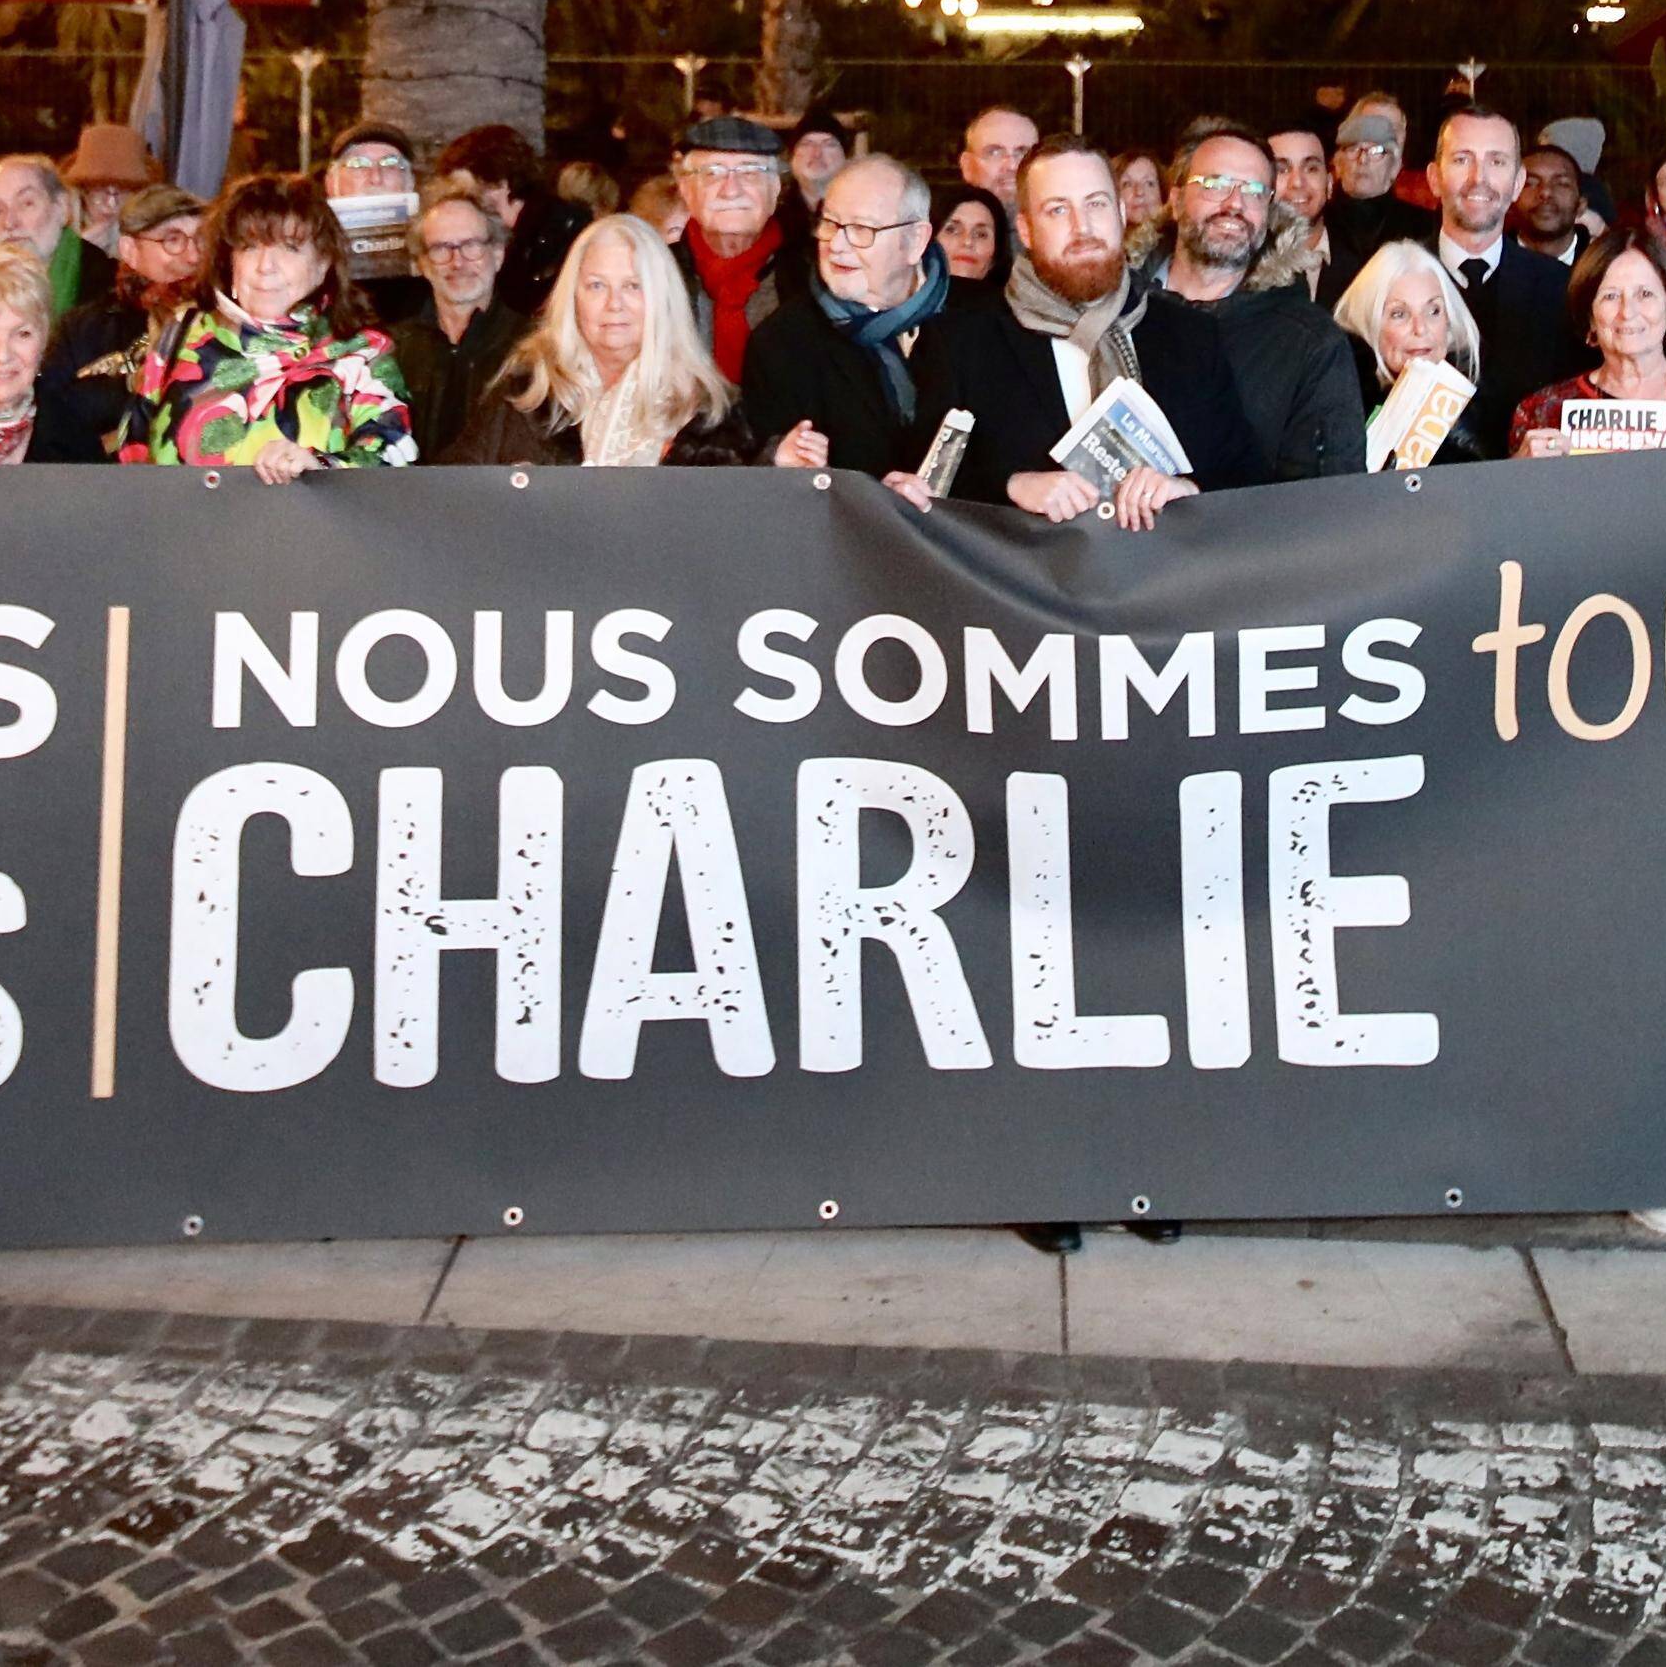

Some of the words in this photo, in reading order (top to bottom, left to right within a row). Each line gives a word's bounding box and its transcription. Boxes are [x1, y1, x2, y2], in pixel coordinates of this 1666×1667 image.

[1080, 431, 1128, 482] Reste
[1567, 408, 1657, 432] CHARLIE
[212, 608, 677, 729] NOUS
[732, 608, 1427, 741] SOMMES
[168, 754, 1440, 1092] CHARLIE
